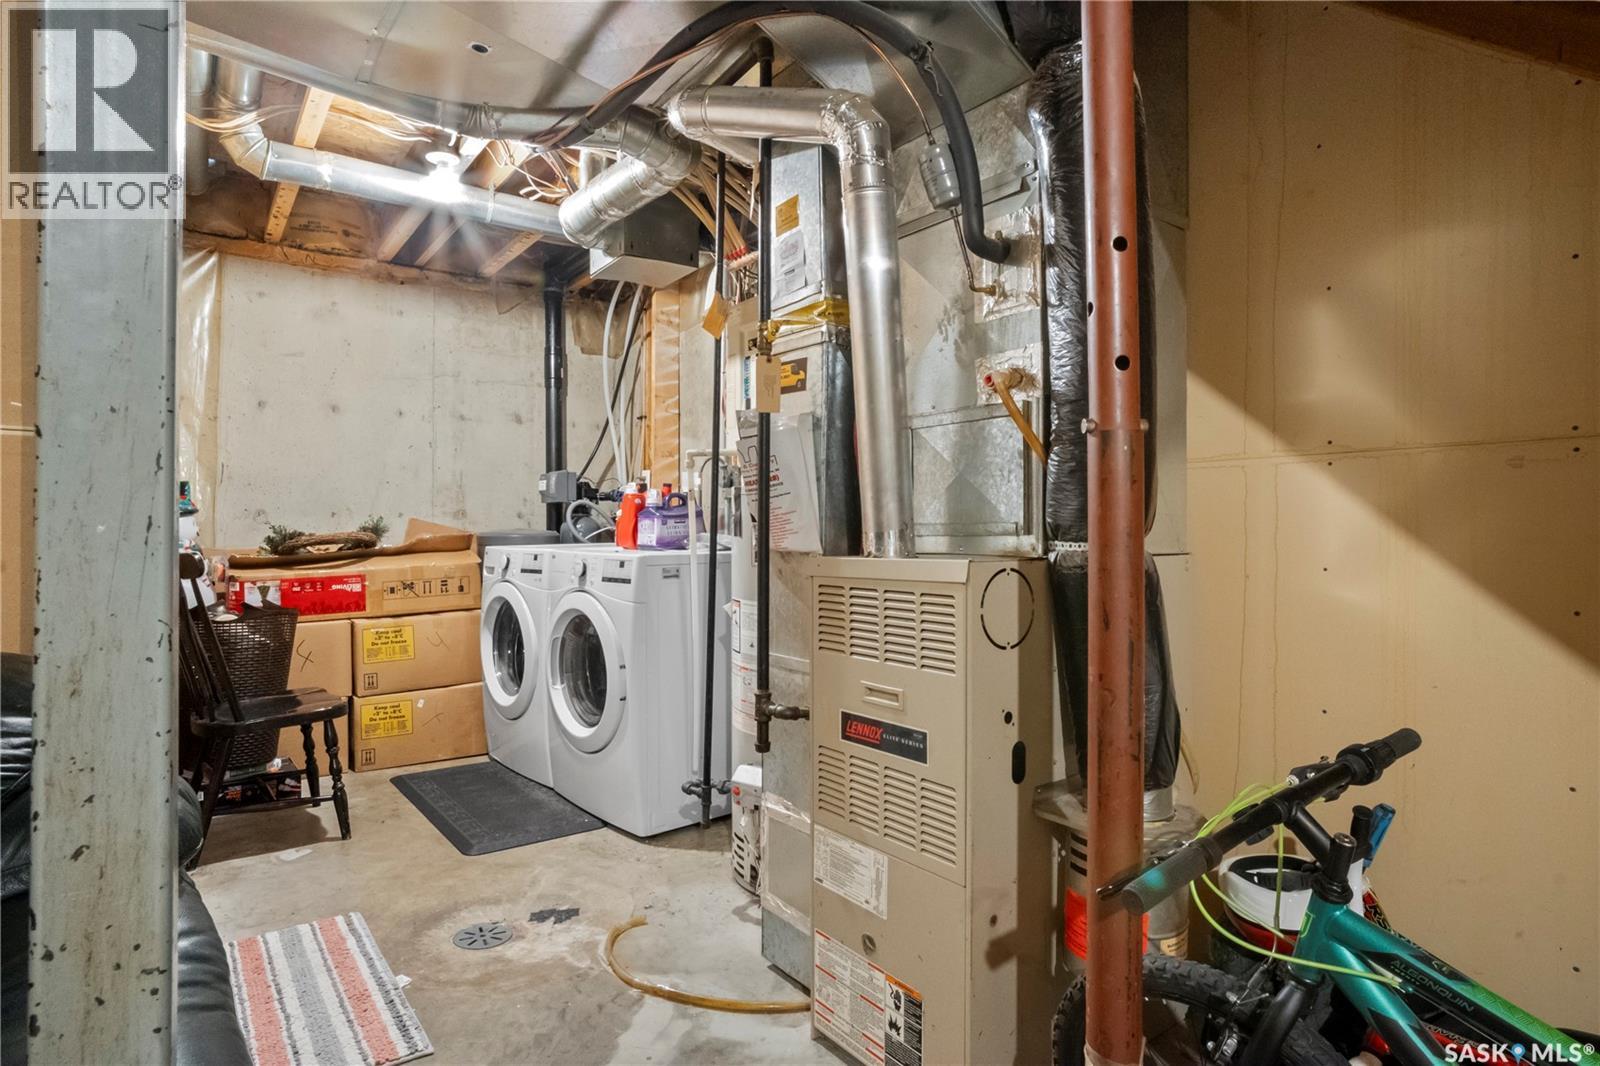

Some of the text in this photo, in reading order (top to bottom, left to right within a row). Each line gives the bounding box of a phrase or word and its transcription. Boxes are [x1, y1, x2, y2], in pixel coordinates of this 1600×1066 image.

[846, 720, 884, 741] LENNOX
[882, 733, 900, 742] ELITE
[901, 736, 924, 750] SERIES
[1391, 960, 1475, 1012] ALGONQUIN
